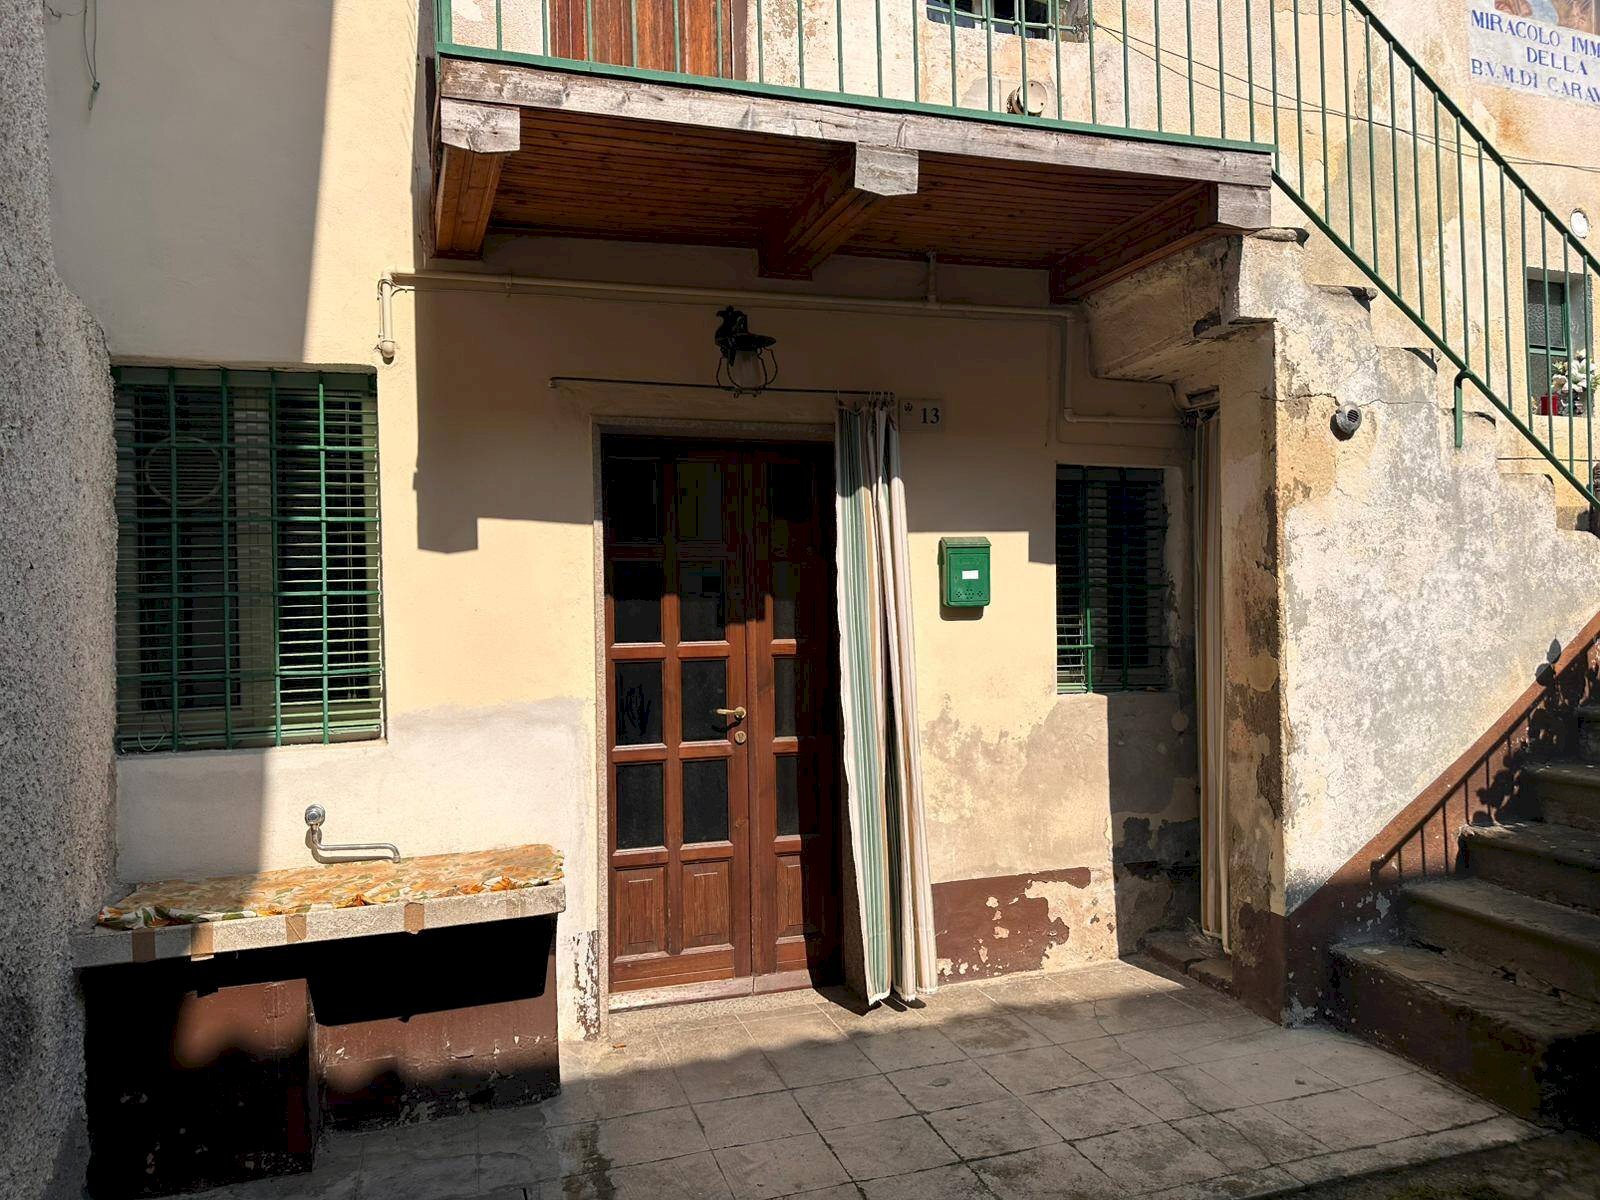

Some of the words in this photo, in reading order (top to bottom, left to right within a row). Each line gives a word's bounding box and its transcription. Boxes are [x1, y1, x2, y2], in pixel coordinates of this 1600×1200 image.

[1471, 9, 1560, 47] MIRACOLO
[1526, 46, 1588, 76] DELLA
[921, 407, 940, 424] 13
